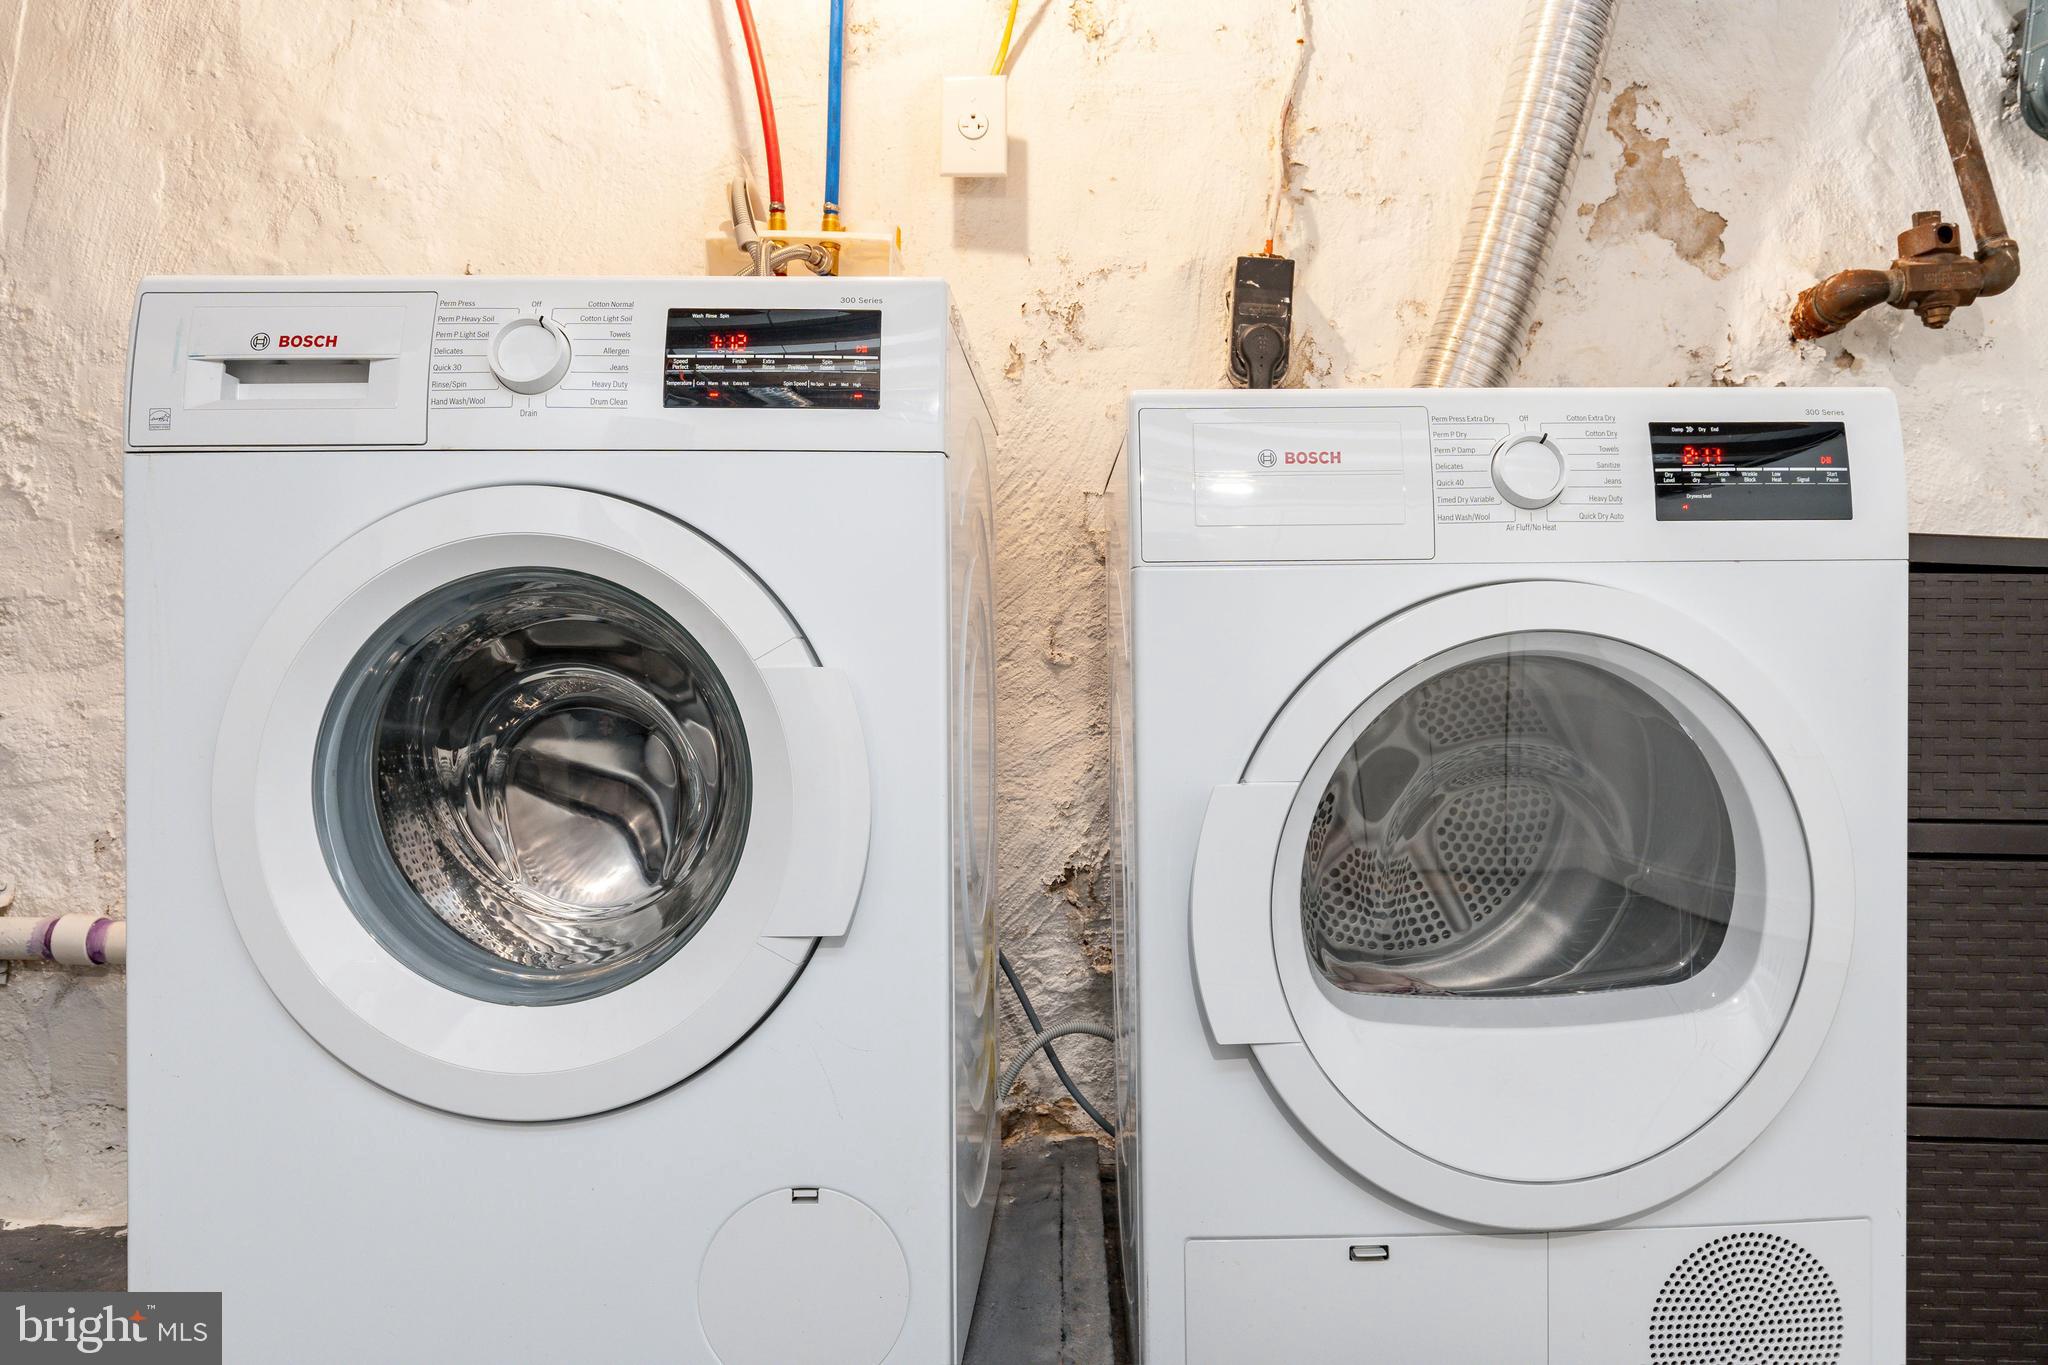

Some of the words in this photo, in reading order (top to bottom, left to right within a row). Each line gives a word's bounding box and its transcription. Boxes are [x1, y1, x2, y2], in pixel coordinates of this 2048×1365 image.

[531, 300, 542, 308] Off
[459, 315, 480, 323] Heavy
[602, 315, 619, 323] Light
[459, 331, 475, 339] Light
[278, 335, 338, 348] BOSCH
[602, 347, 630, 356] Allergen
[431, 380, 467, 389] Rinse/Spin
[591, 380, 612, 389] Heavy
[613, 380, 628, 389] Duty
[430, 397, 448, 405] Hand
[449, 397, 486, 405] Wash/Wool
[519, 409, 537, 417] Drain
[1482, 415, 1495, 423] Dry
[1455, 431, 1467, 439] Dry
[1607, 430, 1618, 438] Dry
[1457, 447, 1476, 455] Damp
[1284, 451, 1342, 465] BOSCH
[1436, 479, 1454, 487] Quick
[1457, 496, 1469, 504] Dry
[1588, 495, 1608, 503] Heavy
[1608, 495, 1623, 503] Duty
[1437, 513, 1454, 521] Hand
[1454, 513, 1491, 521] Wash/Wool
[1578, 513, 1596, 521] Quick
[1597, 513, 1607, 521] Dry
